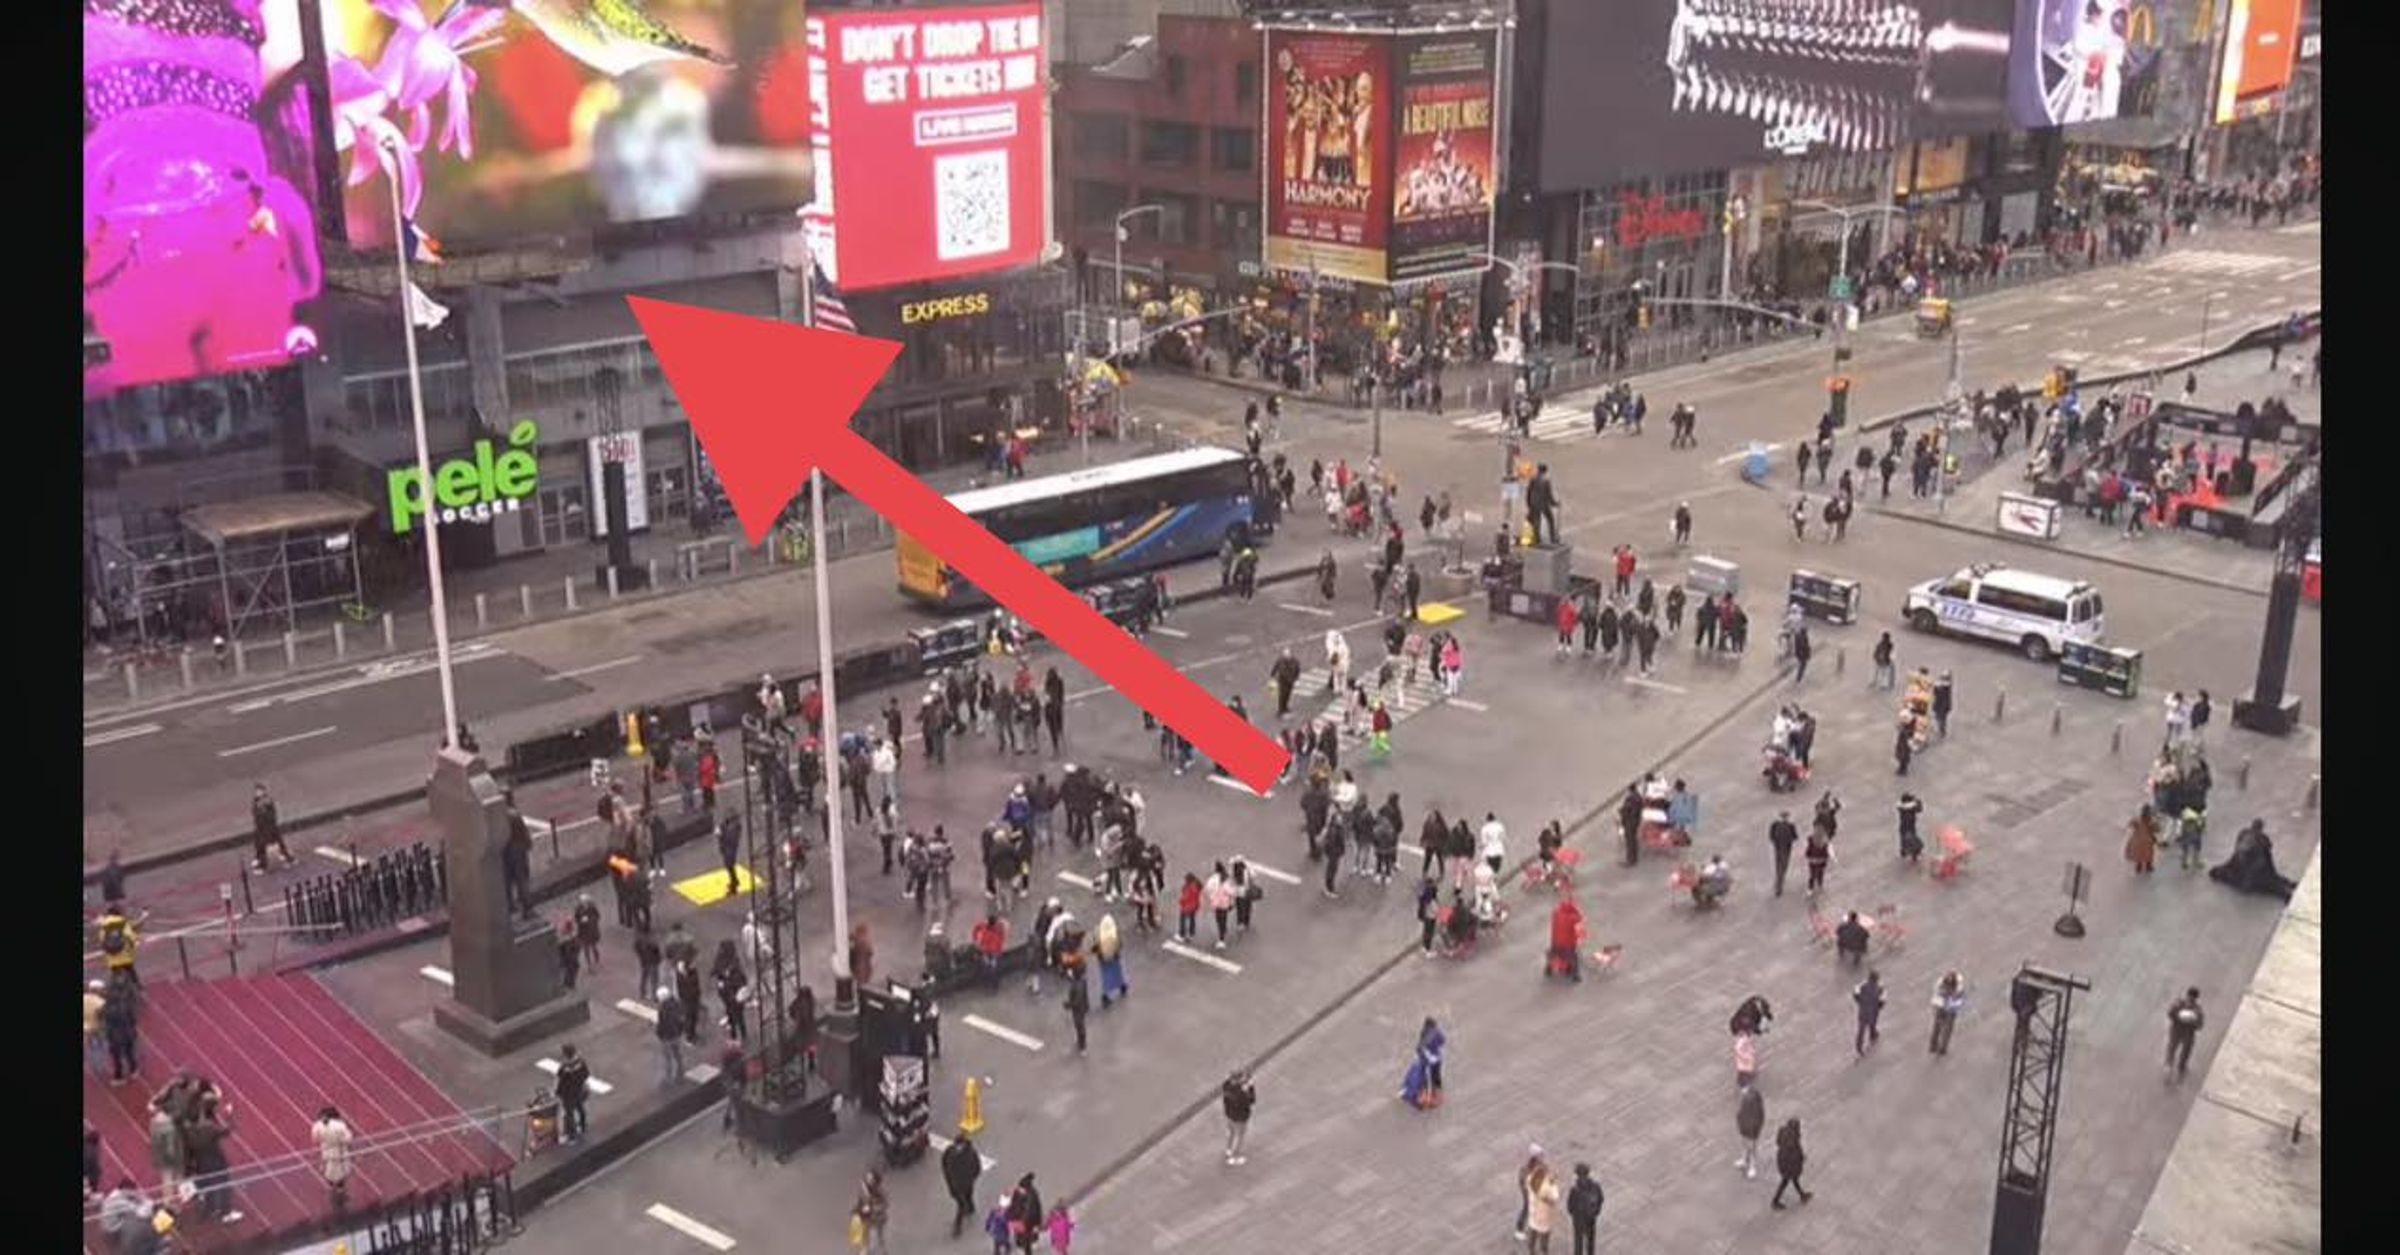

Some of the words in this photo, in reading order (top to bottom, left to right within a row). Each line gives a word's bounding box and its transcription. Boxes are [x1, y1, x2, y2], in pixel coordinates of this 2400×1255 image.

[864, 67, 908, 101] GET
[1285, 181, 1371, 212] HARMONY
[902, 293, 989, 324] EXPRESS
[388, 419, 538, 533] pelé
